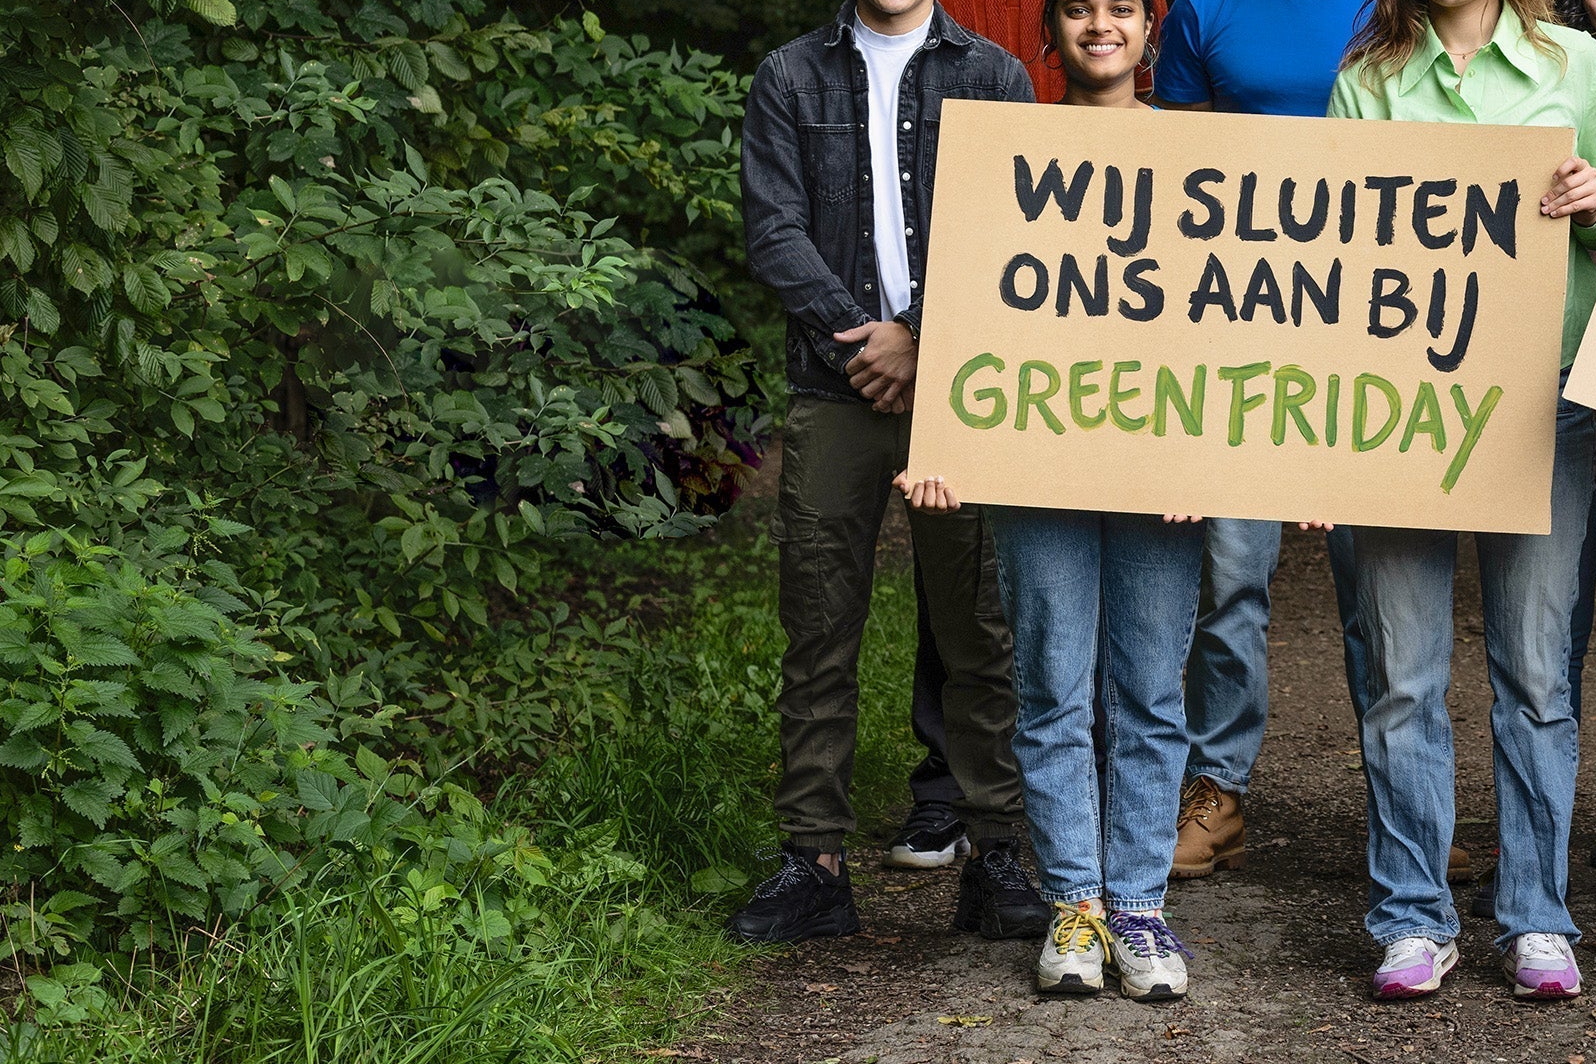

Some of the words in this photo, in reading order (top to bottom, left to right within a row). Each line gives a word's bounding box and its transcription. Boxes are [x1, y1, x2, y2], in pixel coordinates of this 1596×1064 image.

[1013, 154, 1154, 258] WIJ
[1176, 167, 1521, 260] SLUITEN
[998, 251, 1165, 323] ONS
[1187, 251, 1343, 328] AAN
[1366, 266, 1479, 373] BIJ
